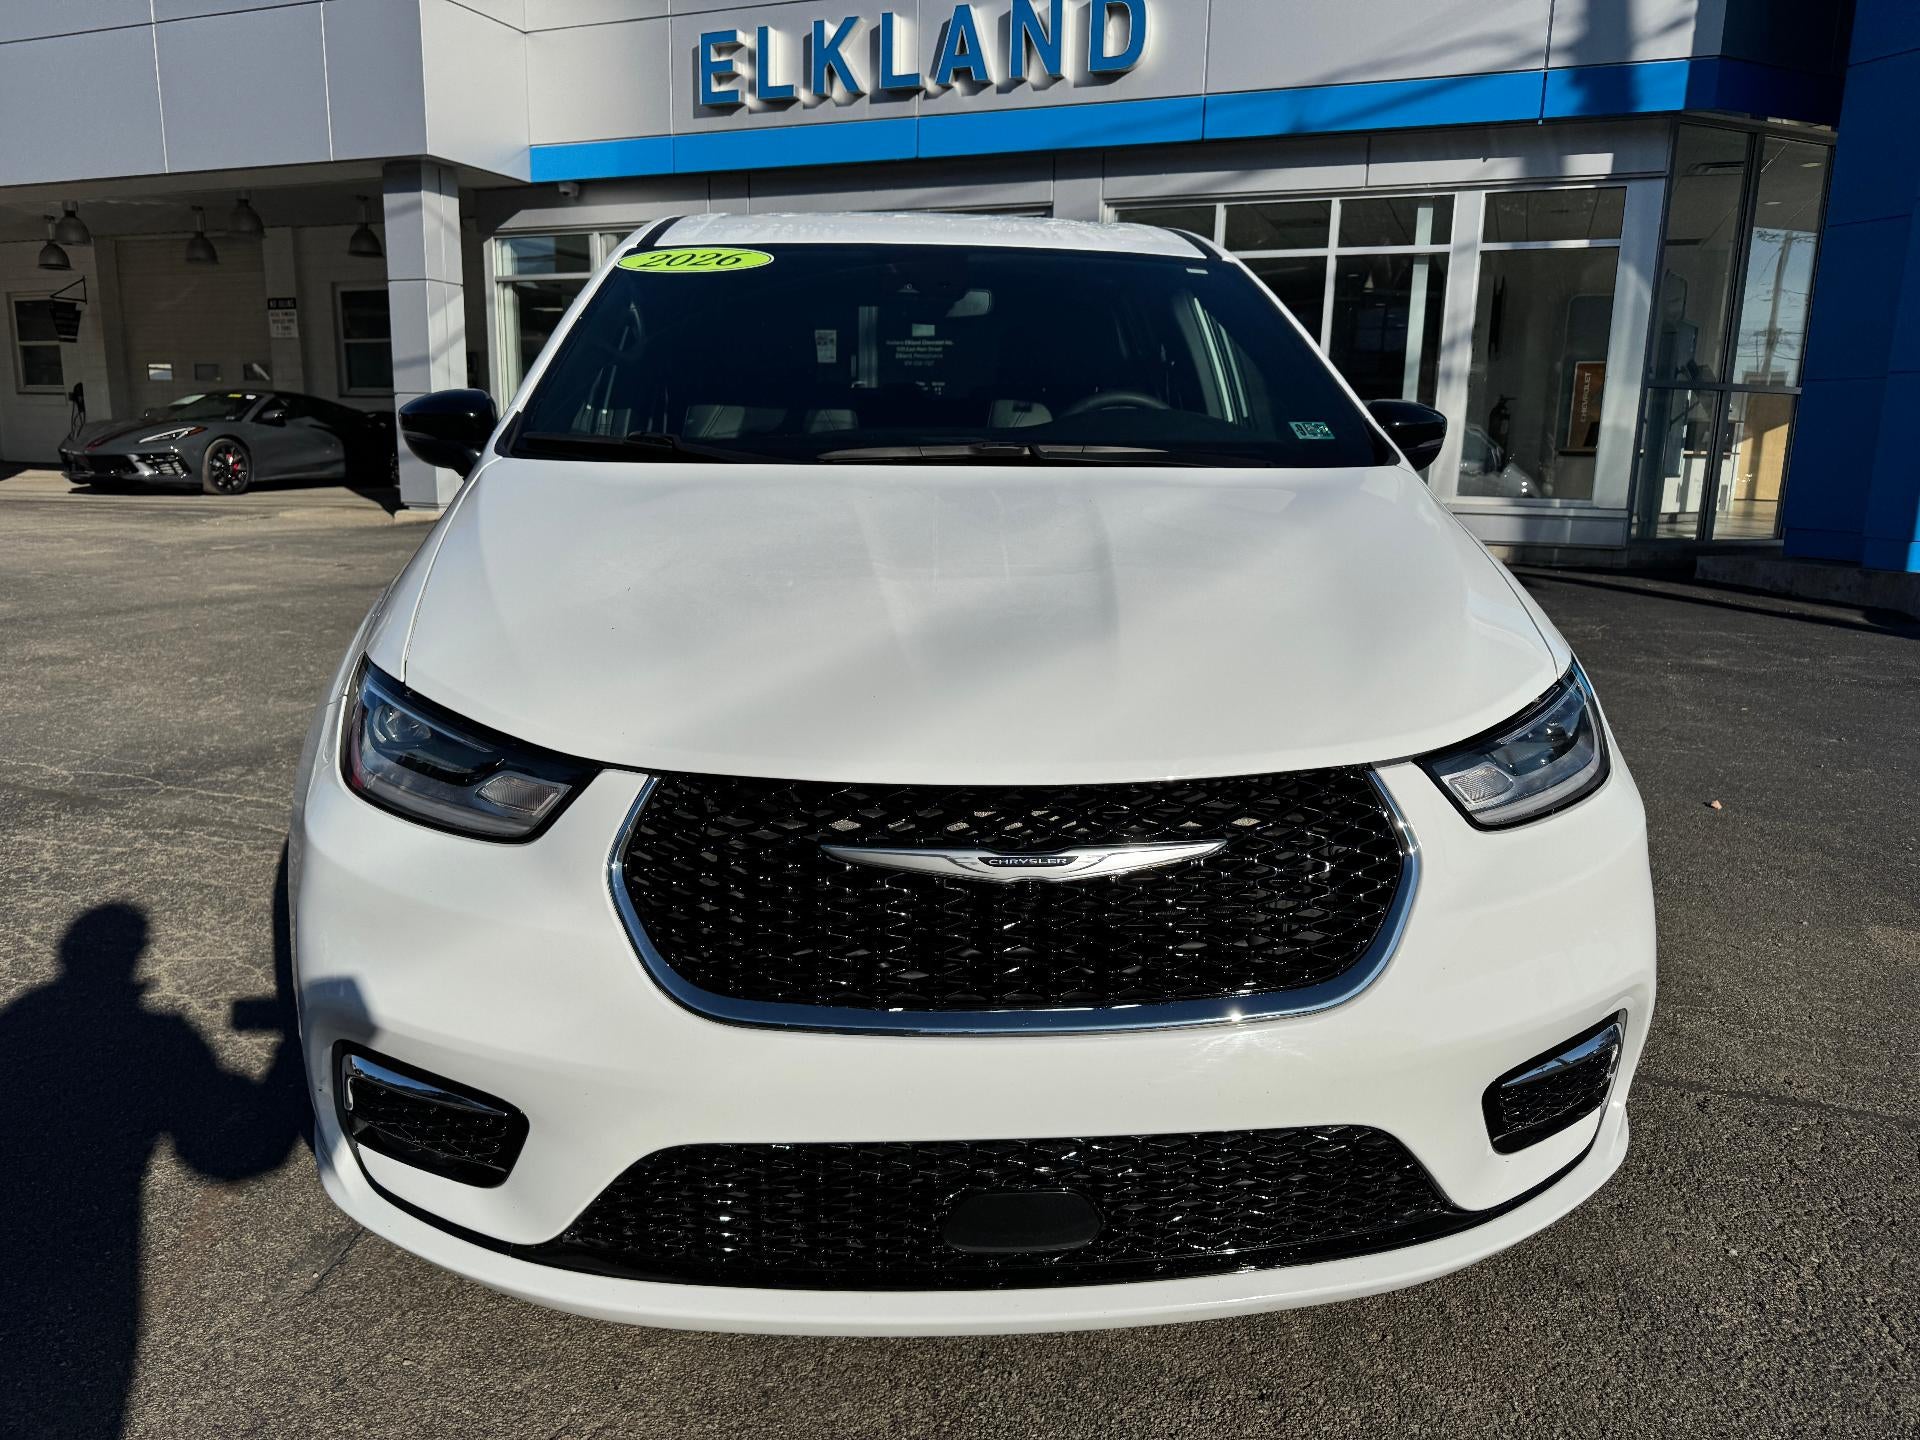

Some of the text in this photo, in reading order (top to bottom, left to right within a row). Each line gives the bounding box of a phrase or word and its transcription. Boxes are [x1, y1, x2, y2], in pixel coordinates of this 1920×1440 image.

[699, 0, 1149, 106] ELKLAND
[637, 252, 752, 268] 2026
[1580, 372, 1593, 423] CHEVROLET
[988, 858, 1067, 866] CHRYSLER
